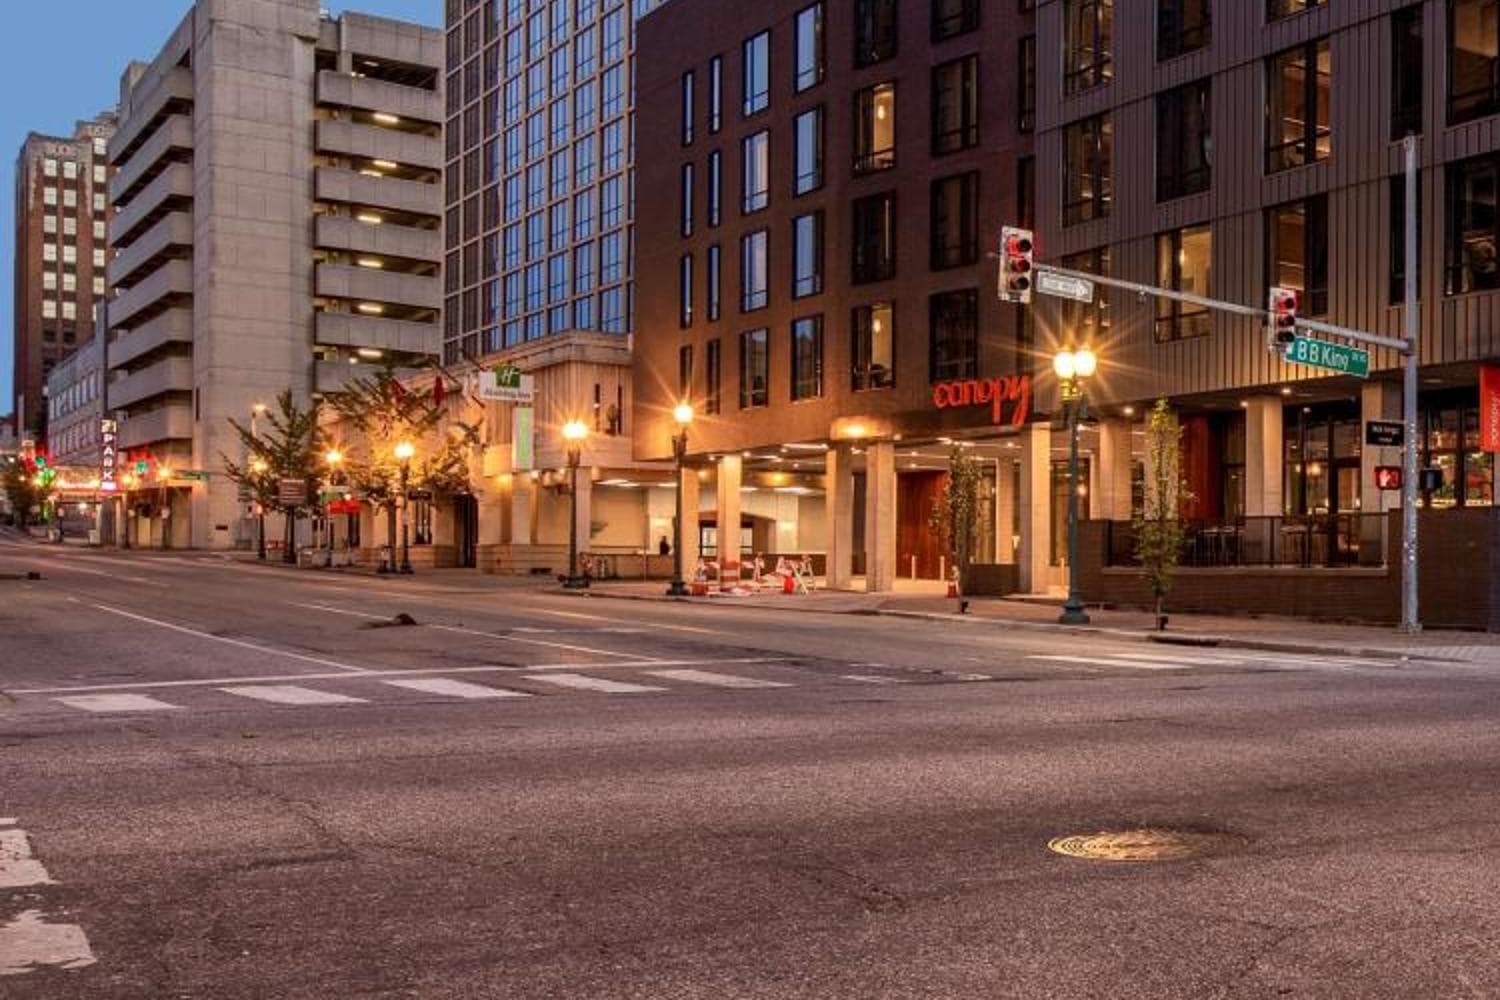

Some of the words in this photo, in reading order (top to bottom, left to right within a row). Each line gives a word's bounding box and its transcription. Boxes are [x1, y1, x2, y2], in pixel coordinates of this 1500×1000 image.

[1321, 345, 1350, 372] King
[933, 375, 1030, 428] canopy
[103, 433, 114, 481] PARK
